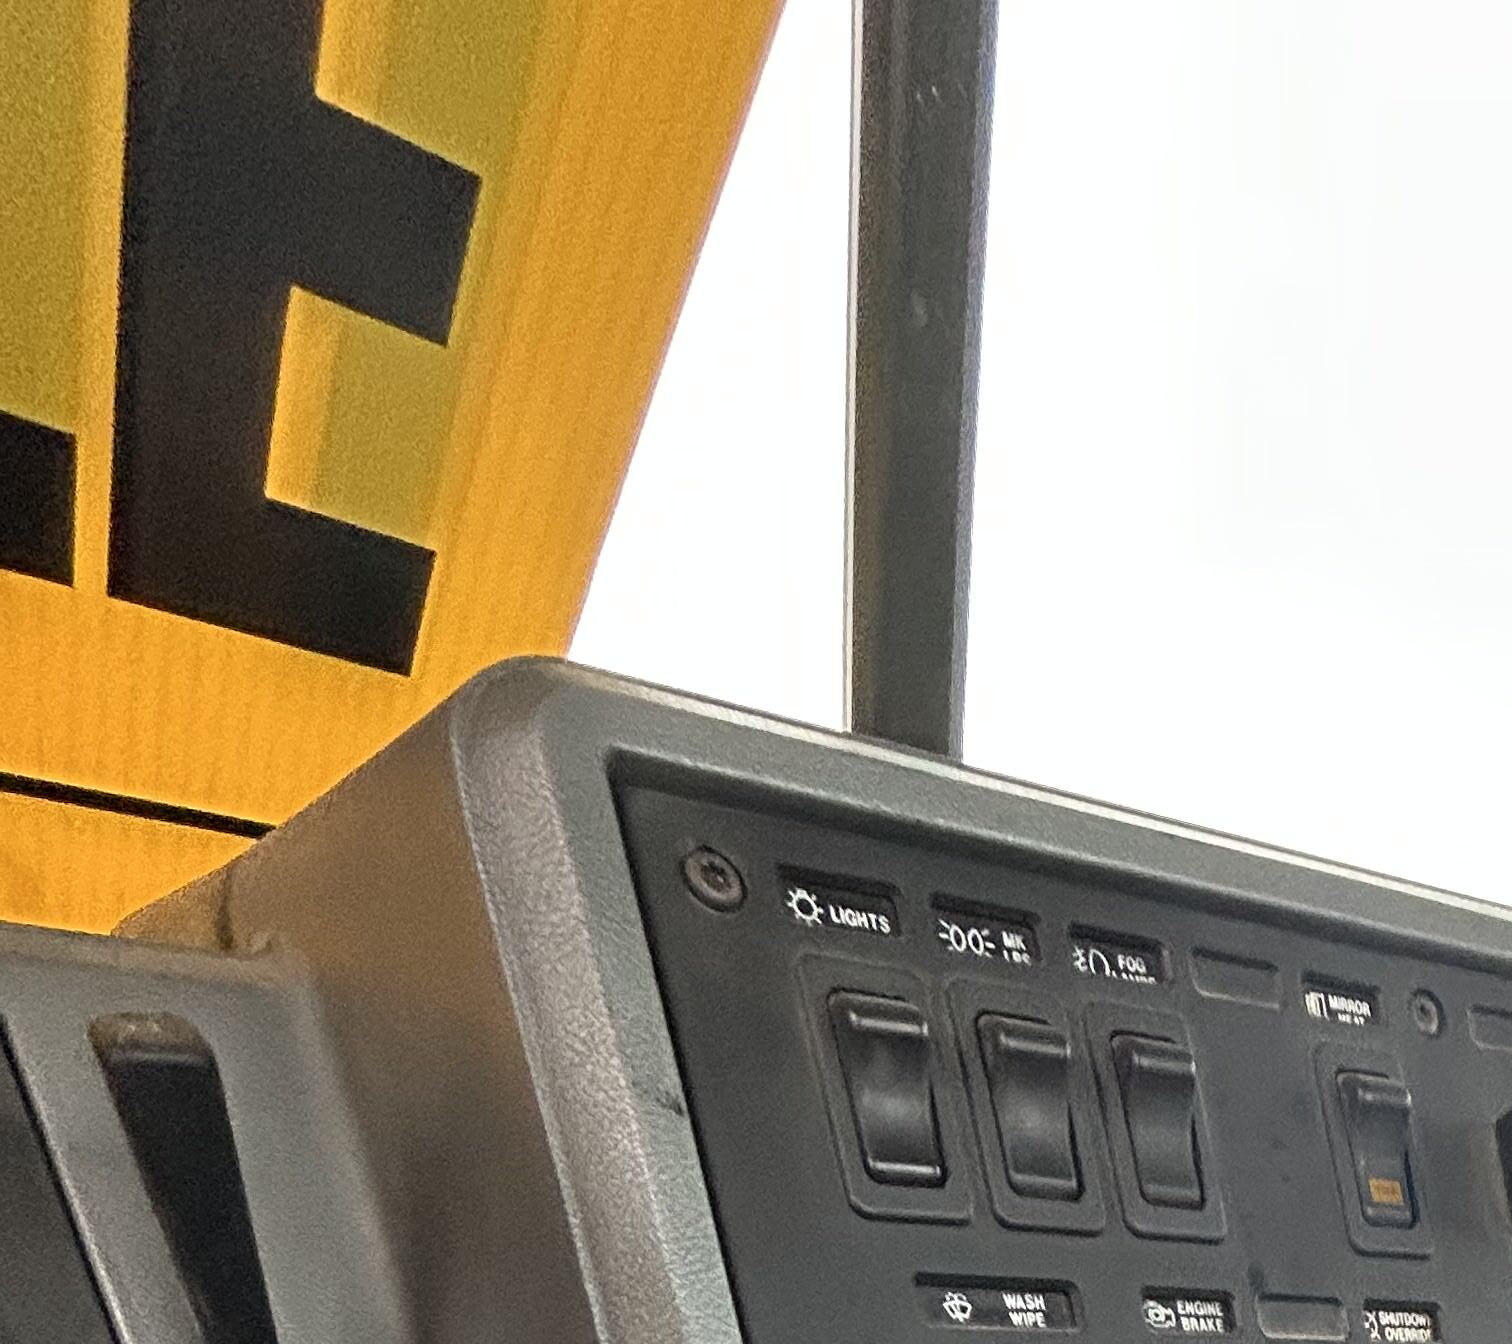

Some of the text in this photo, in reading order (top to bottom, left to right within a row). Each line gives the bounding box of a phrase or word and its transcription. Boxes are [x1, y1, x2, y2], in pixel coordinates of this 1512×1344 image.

[829, 905, 891, 934] LIGHTS
[1117, 954, 1147, 973] FOG
[1328, 994, 1372, 1018] MIRROR
[1002, 1293, 1046, 1311] WASH
[1177, 1300, 1224, 1317] ENGINE
[1008, 1311, 1047, 1328] WIPE
[1181, 1316, 1225, 1333] BRAKE
